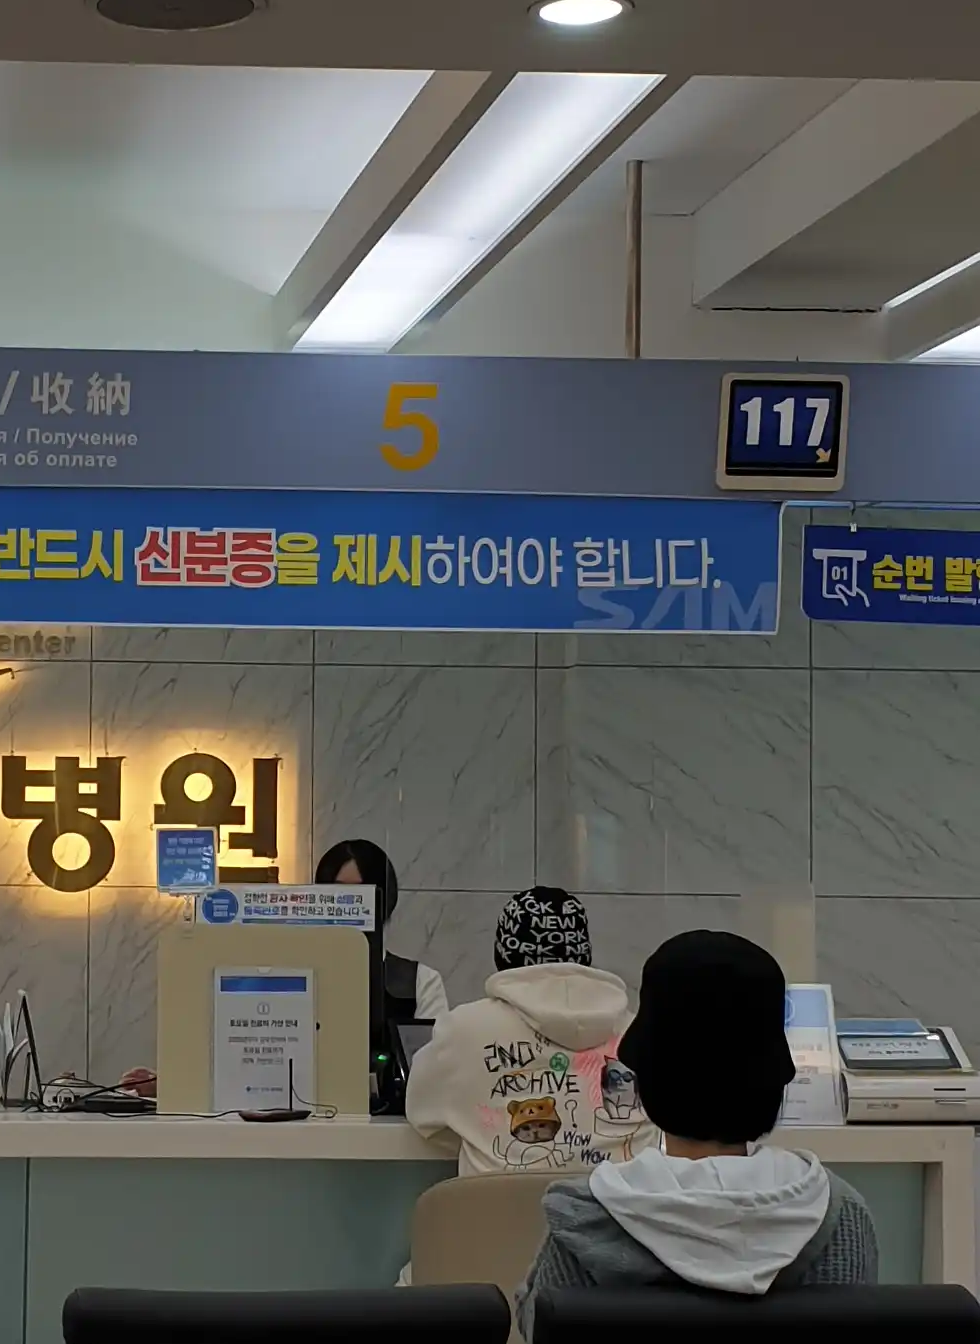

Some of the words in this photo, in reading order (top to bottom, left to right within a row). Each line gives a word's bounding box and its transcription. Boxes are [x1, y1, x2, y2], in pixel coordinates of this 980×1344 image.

[378, 381, 440, 472] 5
[739, 396, 831, 448] 117
[26, 428, 139, 450] Получение
[13, 449, 40, 466] об
[45, 453, 118, 469] оплате
[134, 526, 320, 588] 신분증을
[331, 533, 563, 588] 제시하여야
[571, 537, 722, 589] 합니다.
[831, 566, 848, 581] 01
[872, 554, 934, 591] 순번
[945, 556, 980, 593] 발
[573, 581, 777, 630] SAM
[530, 929, 587, 944] YORK
[531, 916, 576, 929] NEW
[500, 928, 555, 956] YORK
[566, 942, 592, 956] NE
[483, 1041, 536, 1073] 2ND
[490, 1069, 580, 1099] ARCHIVE
